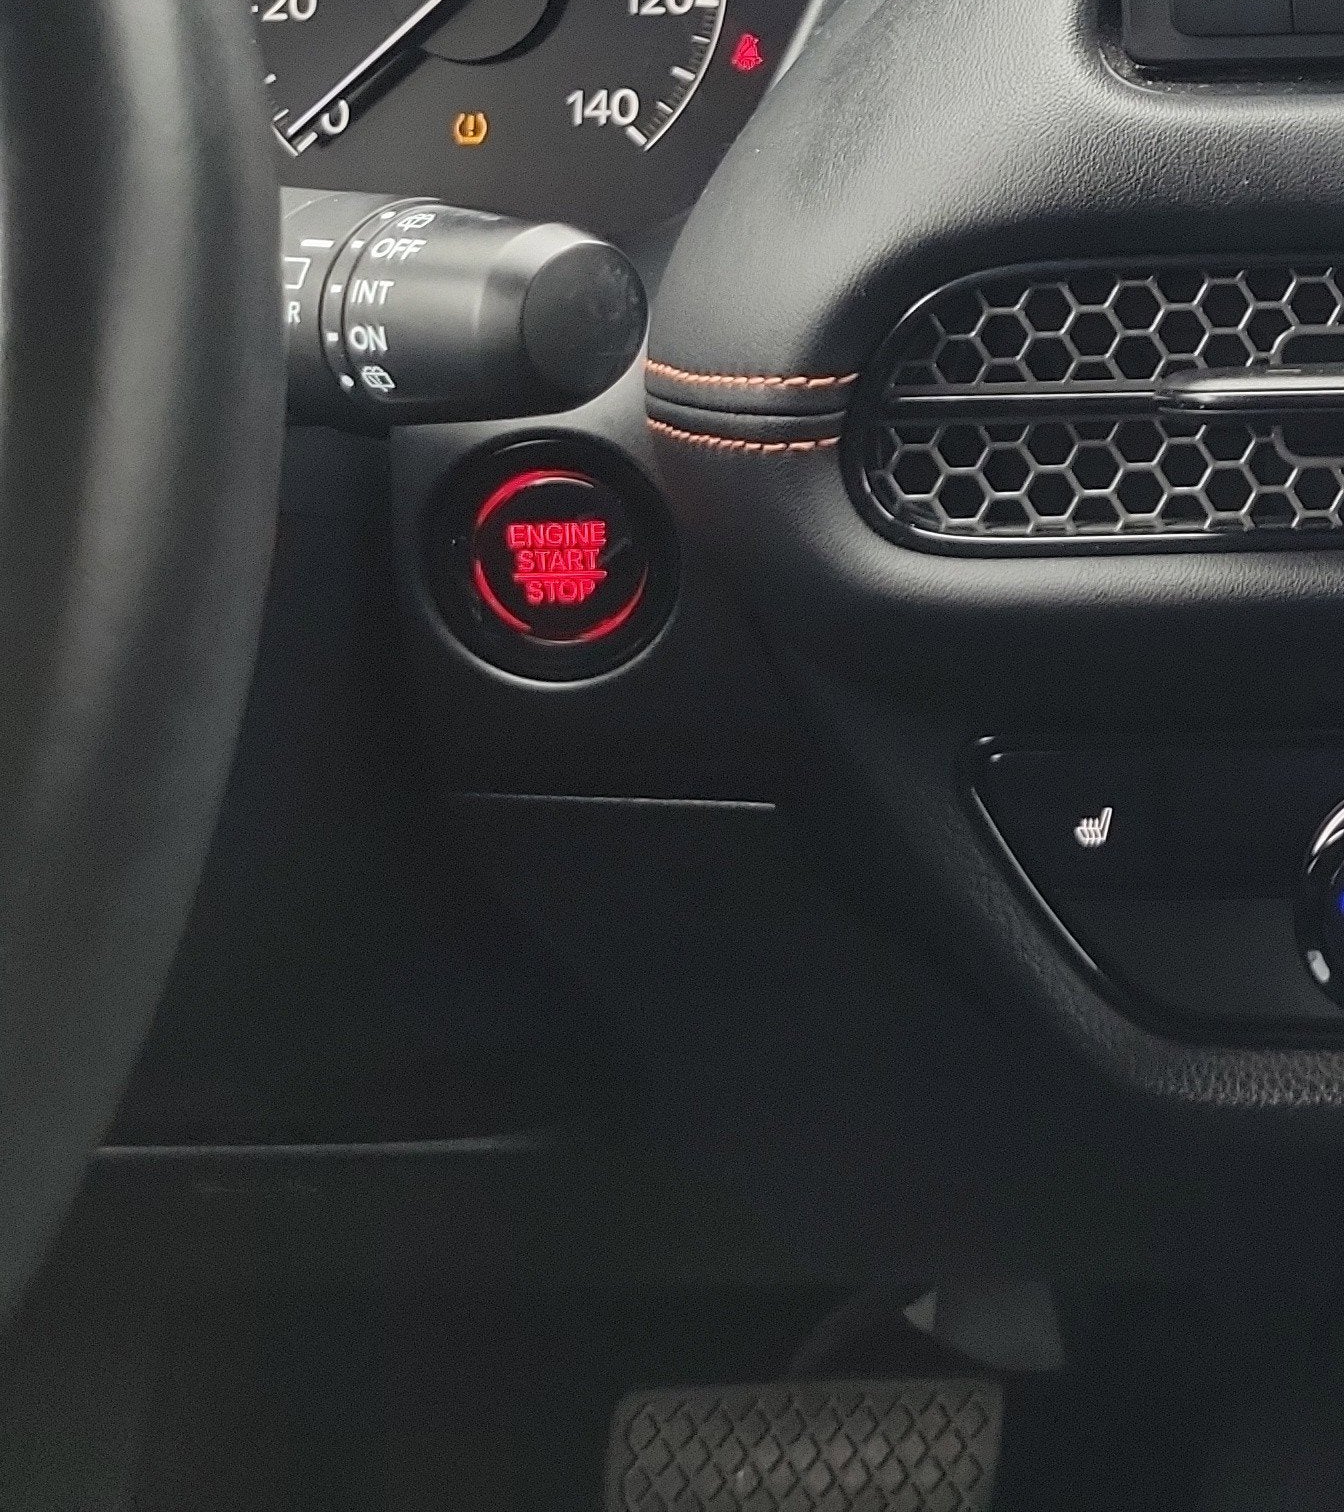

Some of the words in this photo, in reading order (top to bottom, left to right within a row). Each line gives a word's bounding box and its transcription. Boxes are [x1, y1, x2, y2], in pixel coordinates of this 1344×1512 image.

[566, 88, 639, 126] 140
[370, 237, 427, 260] OFF
[350, 279, 395, 305] INT
[350, 325, 388, 352] ON
[509, 522, 607, 549] ENGINE
[517, 549, 602, 572] START
[525, 579, 597, 603] STOP
